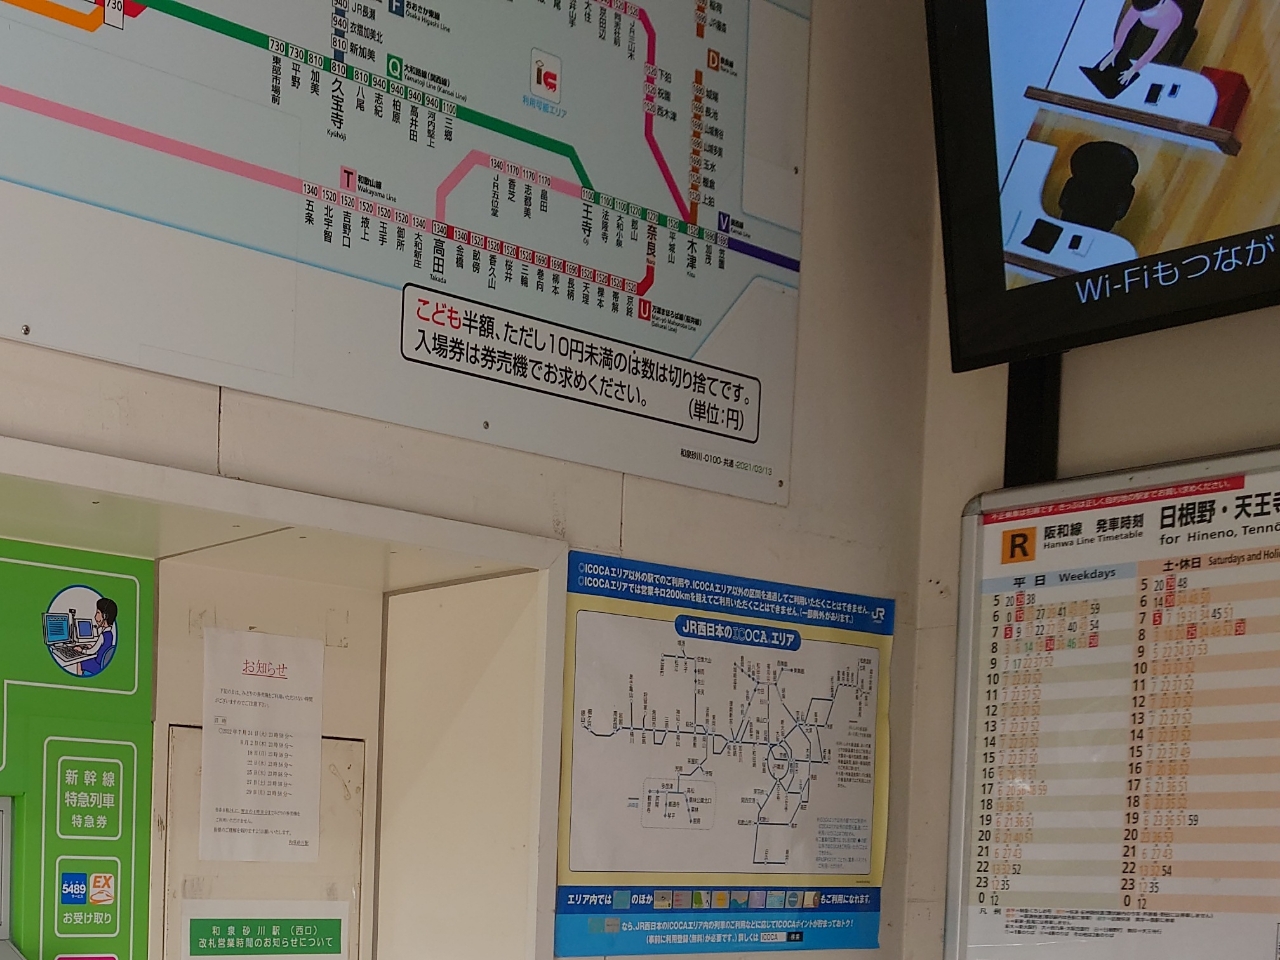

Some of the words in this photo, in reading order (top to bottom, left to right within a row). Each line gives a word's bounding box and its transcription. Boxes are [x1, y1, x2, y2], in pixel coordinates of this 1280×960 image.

[270, 39, 285, 53] 730
[289, 46, 304, 60] 730
[350, 42, 376, 62] 新加美
[309, 53, 323, 67] 810
[332, 61, 346, 75] 810
[291, 63, 301, 89] 平野
[310, 69, 320, 96] 加美
[355, 70, 368, 83] 810
[373, 77, 386, 90] 940
[390, 83, 404, 96] 940
[331, 78, 344, 130] 久宝寺
[355, 86, 365, 112] 八尾
[374, 93, 383, 118] 志紀
[392, 99, 401, 124] 柏原
[410, 105, 419, 142] 高井田
[303, 184, 317, 196] 1340
[322, 190, 336, 202] 1520
[340, 195, 355, 207] 1520
[305, 200, 314, 225] 五条
[324, 205, 333, 243] 北宇智
[342, 211, 351, 248] 吉野口
[379, 222, 388, 246] 玉手
[396, 227, 405, 251] 御所
[433, 239, 445, 274] 高田
[488, 254, 496, 290] 香久山
[1076, 234, 1275, 303] Wi-Fiもつなが
[414, 329, 647, 407] 入場券は券売機でお求めください。
[1044, 522, 1083, 539] 阪和線
[1096, 513, 1144, 532] 発車時刻
[1010, 533, 1028, 558] R
[1044, 539, 1074, 550] Hanwa
[1077, 536, 1095, 546] Line
[1097, 529, 1143, 543] Timetable
[1159, 533, 1179, 546] for
[1187, 528, 1237, 542] Hineno,
[1208, 552, 1245, 566] Saturdays
[1059, 567, 1116, 583] Weekdays
[242, 659, 288, 677] お知らせ
[65, 769, 115, 787] 新幹線
[65, 792, 115, 808] 特急列車
[72, 815, 107, 828] 特急券
[62, 884, 86, 894] 5489
[92, 876, 112, 888] EX
[568, 894, 612, 905] エリア内では
[632, 895, 653, 905] のほか
[63, 912, 111, 924] お受け取り
[199, 937, 333, 948] 改札営業時間のお知らせについて
